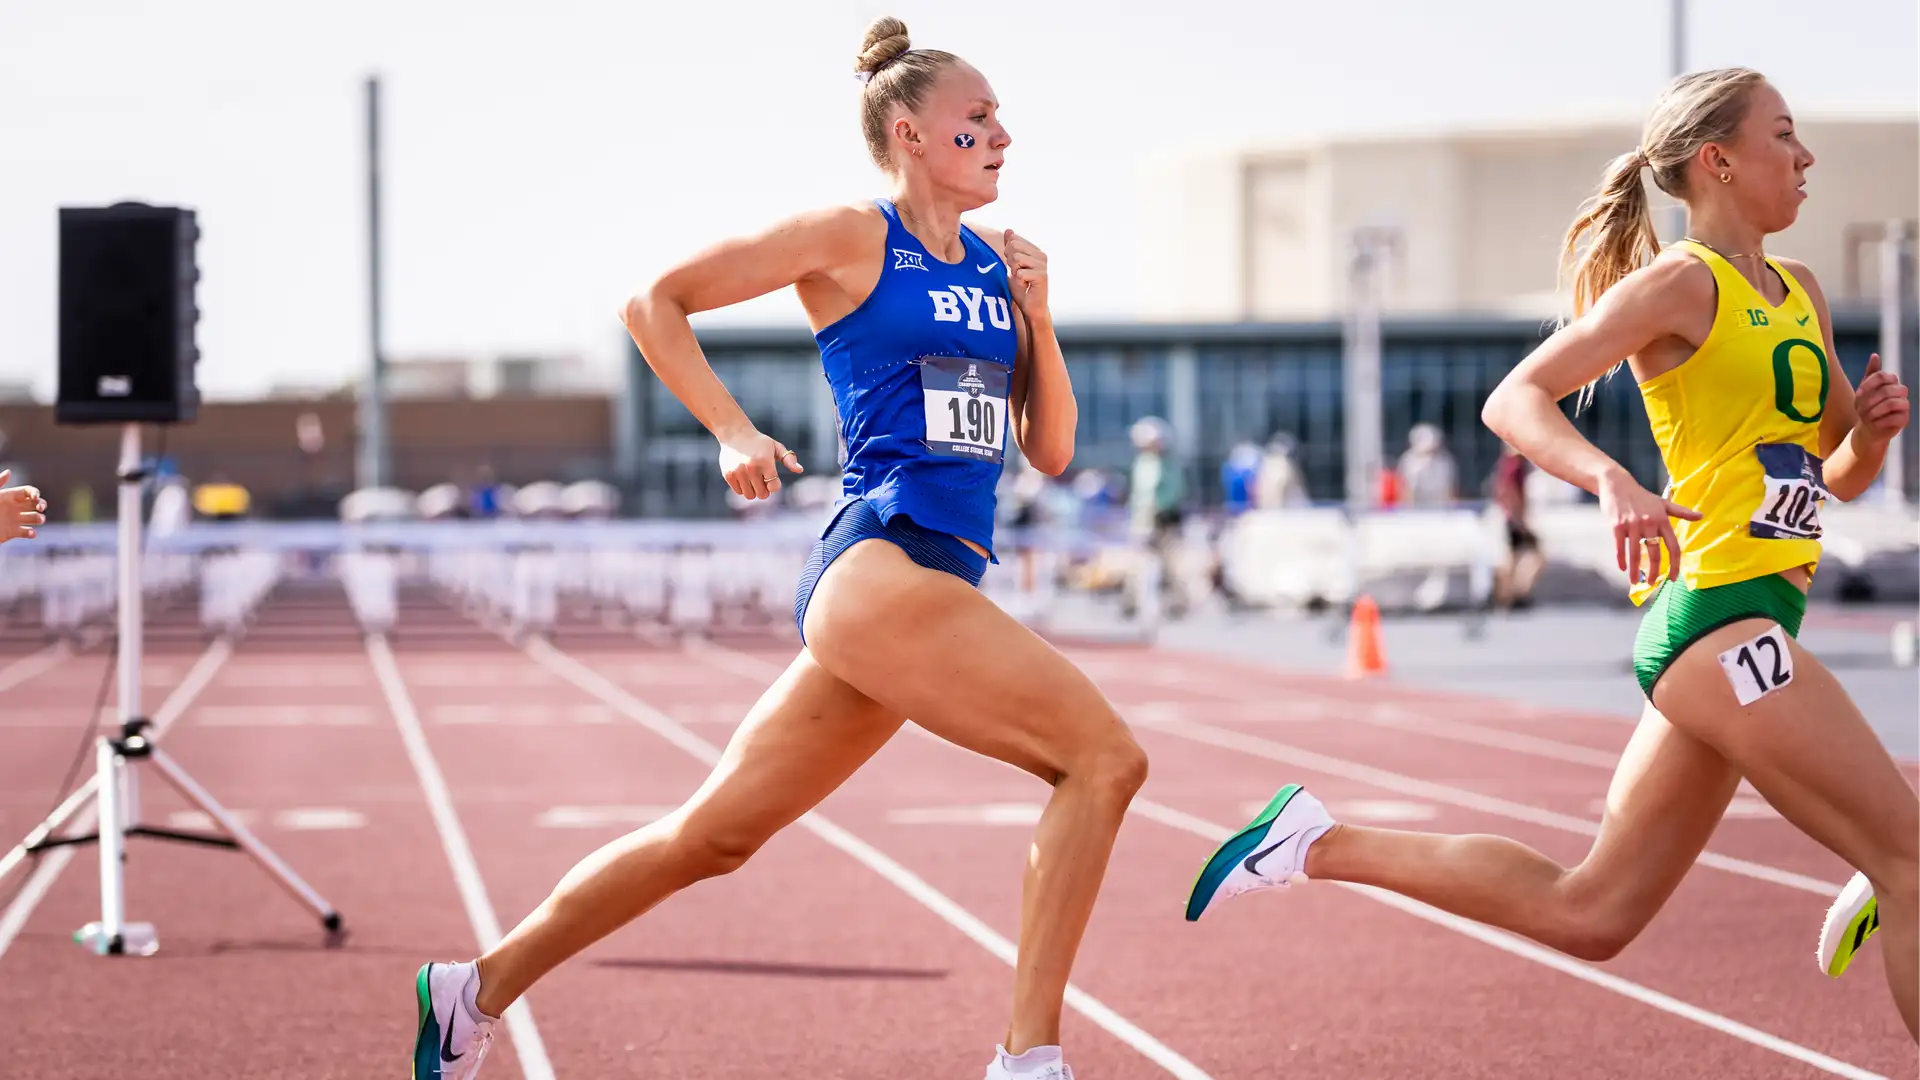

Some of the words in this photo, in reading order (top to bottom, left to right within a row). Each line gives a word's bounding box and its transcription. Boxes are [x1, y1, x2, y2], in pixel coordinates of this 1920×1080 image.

[957, 134, 973, 148] Y
[927, 284, 1011, 332] BYU
[1772, 338, 1829, 424] O
[947, 397, 995, 445] 190
[1736, 635, 1791, 693] 12
